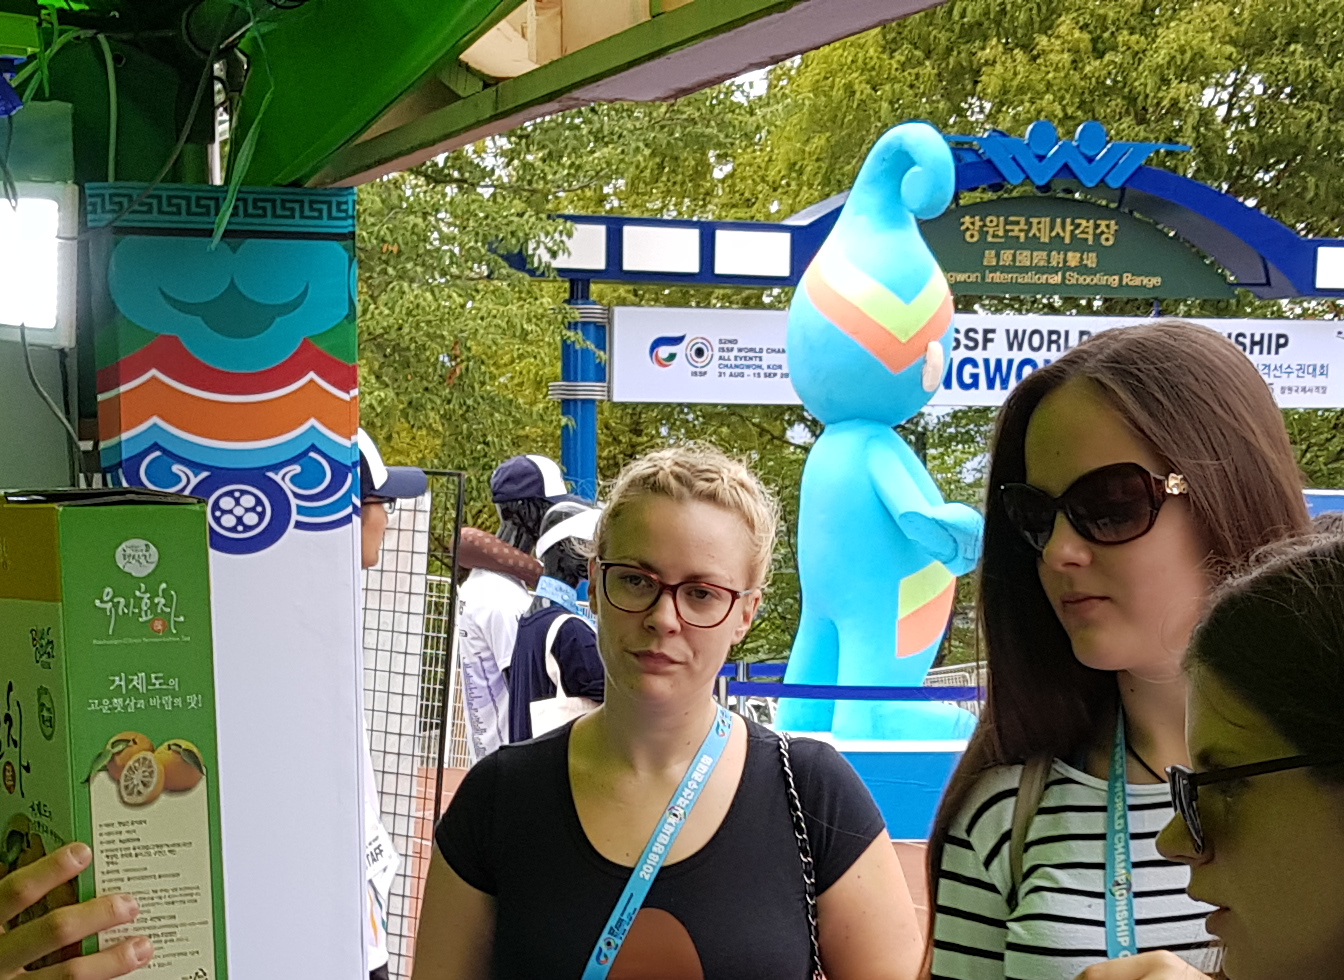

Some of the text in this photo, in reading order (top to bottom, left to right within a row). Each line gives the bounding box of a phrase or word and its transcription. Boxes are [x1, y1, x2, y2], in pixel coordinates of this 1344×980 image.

[960, 215, 1119, 247] 창원국제사격장
[945, 270, 1162, 289] gwon International Shooting Range
[952, 328, 997, 351] SSF
[1229, 332, 1289, 356] SHIP
[1258, 363, 1330, 379] 격선수권대회
[109, 672, 180, 695] 거제도의
[1113, 782, 1126, 831] WORLD
[366, 843, 384, 868] TAFF
[1113, 832, 1131, 947] CHAMPIONSHIP
